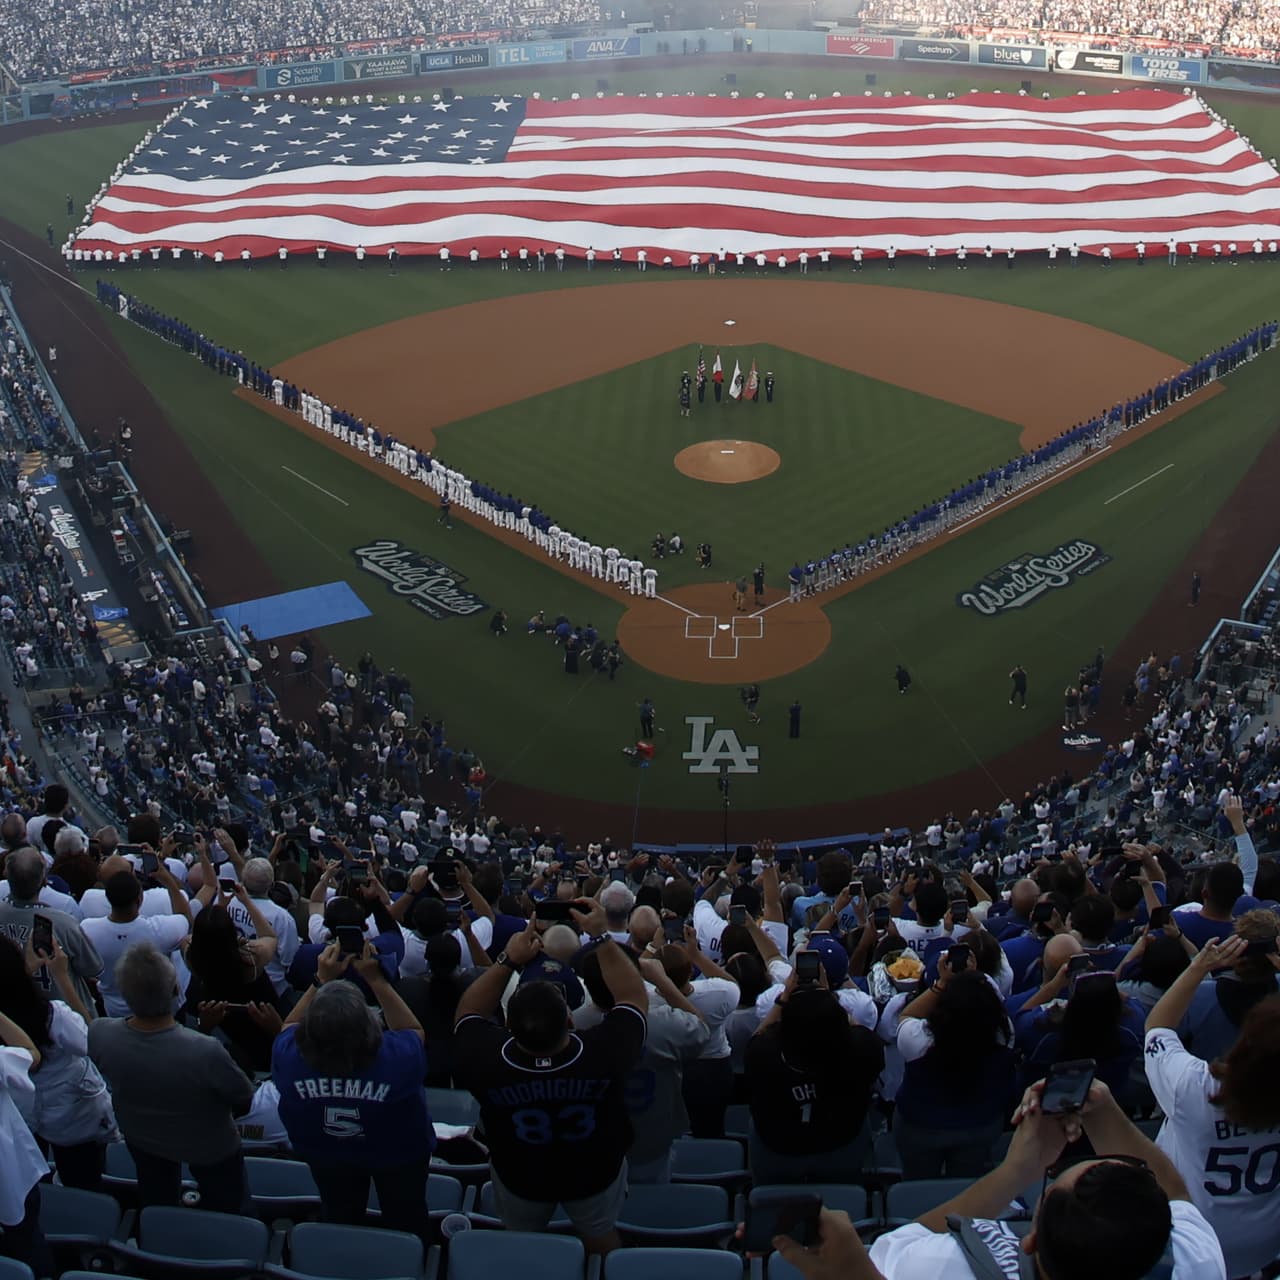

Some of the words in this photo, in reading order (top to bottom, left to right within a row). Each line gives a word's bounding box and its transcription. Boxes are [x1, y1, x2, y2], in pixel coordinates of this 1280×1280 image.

[586, 40, 613, 53] ANA
[860, 36, 887, 44] AMERICA
[498, 47, 530, 64] TEL
[918, 45, 954, 55] Spectrum
[994, 48, 1020, 60] blue
[429, 56, 450, 66] UCLA
[454, 53, 484, 66] Health
[1142, 57, 1179, 70] TOYO
[294, 65, 322, 75] Security
[1148, 68, 1190, 81] TIRES
[294, 74, 320, 84] Benefit
[682, 716, 760, 773] LA
[293, 1076, 392, 1103] FREEMAN
[487, 1077, 612, 1106] RODRIGUEZ
[321, 1104, 366, 1137] 5
[511, 1103, 597, 1145] 83
